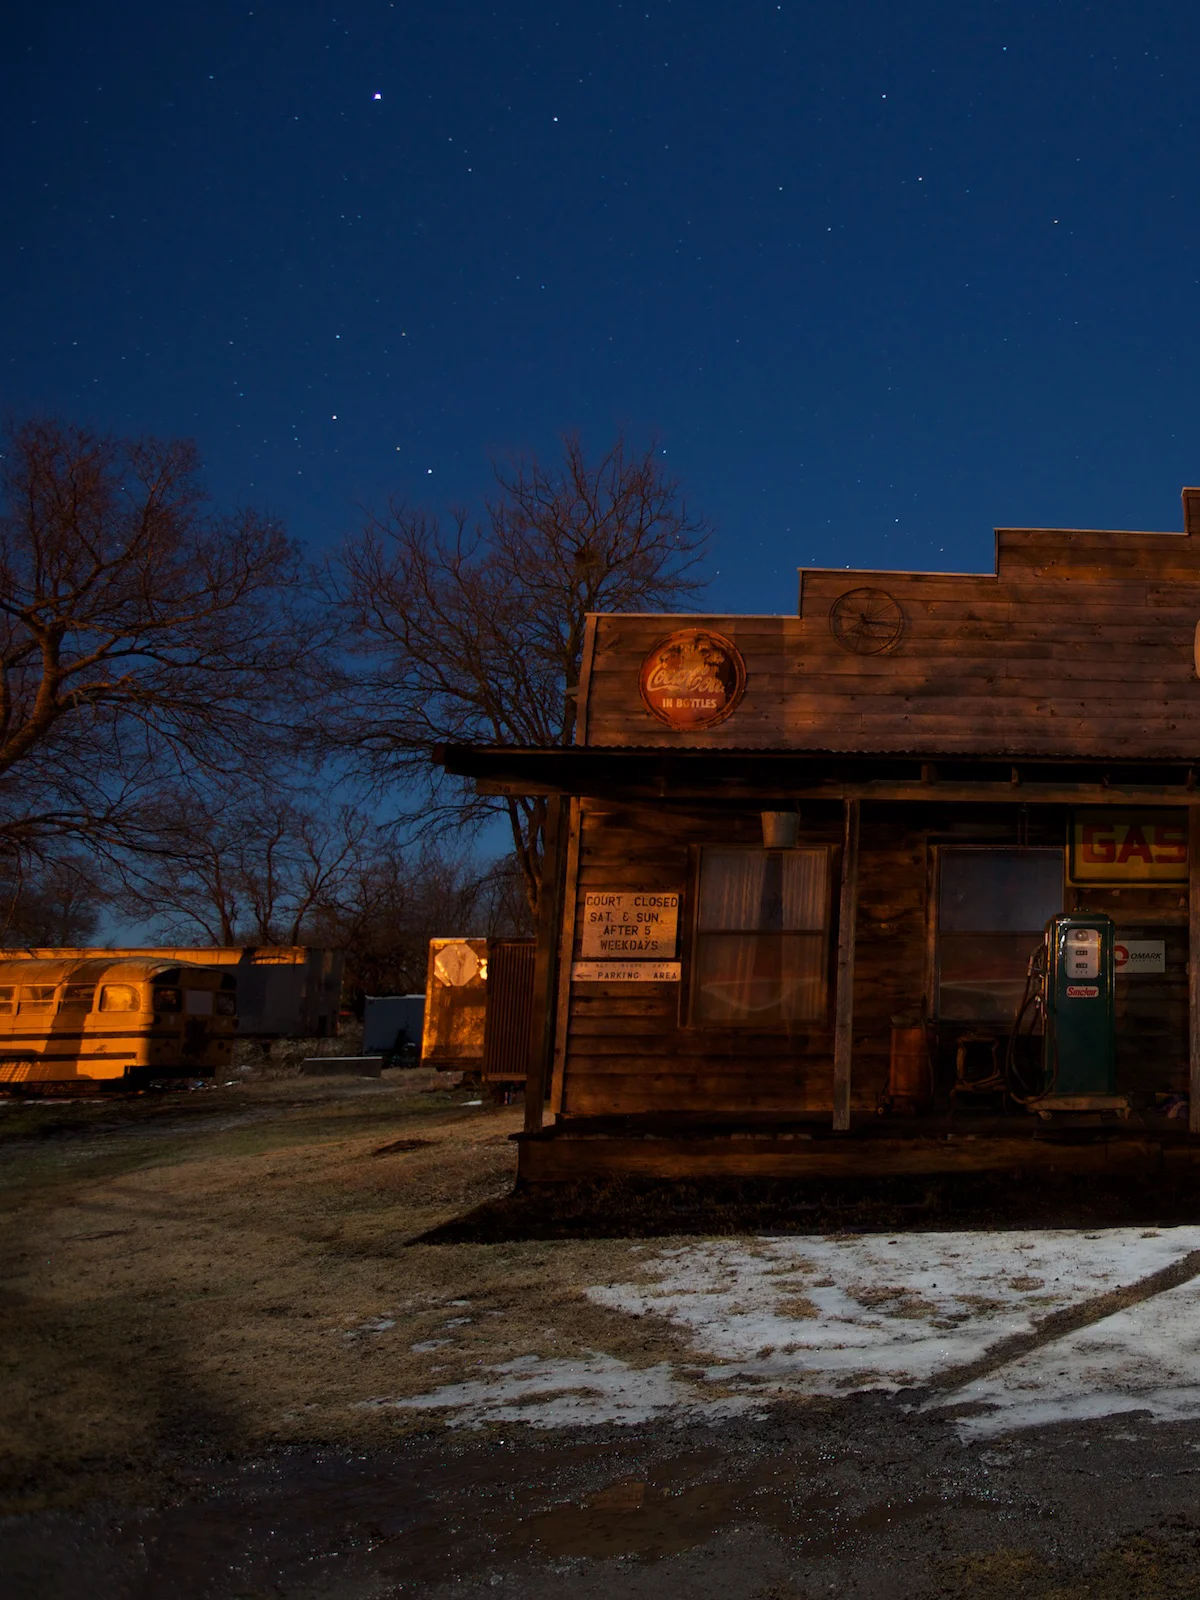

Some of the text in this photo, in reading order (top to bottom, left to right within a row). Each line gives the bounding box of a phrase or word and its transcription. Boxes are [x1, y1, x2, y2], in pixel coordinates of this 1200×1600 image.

[663, 698, 717, 709] IN BOTTLES
[1083, 825, 1187, 863] GAS
[586, 896, 678, 907] COURT CLOSED
[622, 912, 630, 922] &
[603, 925, 652, 936] AFTER 5
[600, 940, 659, 951] WEEKDAYS
[597, 971, 677, 980] PARKING AREA
[1067, 987, 1098, 997] Sinclair
